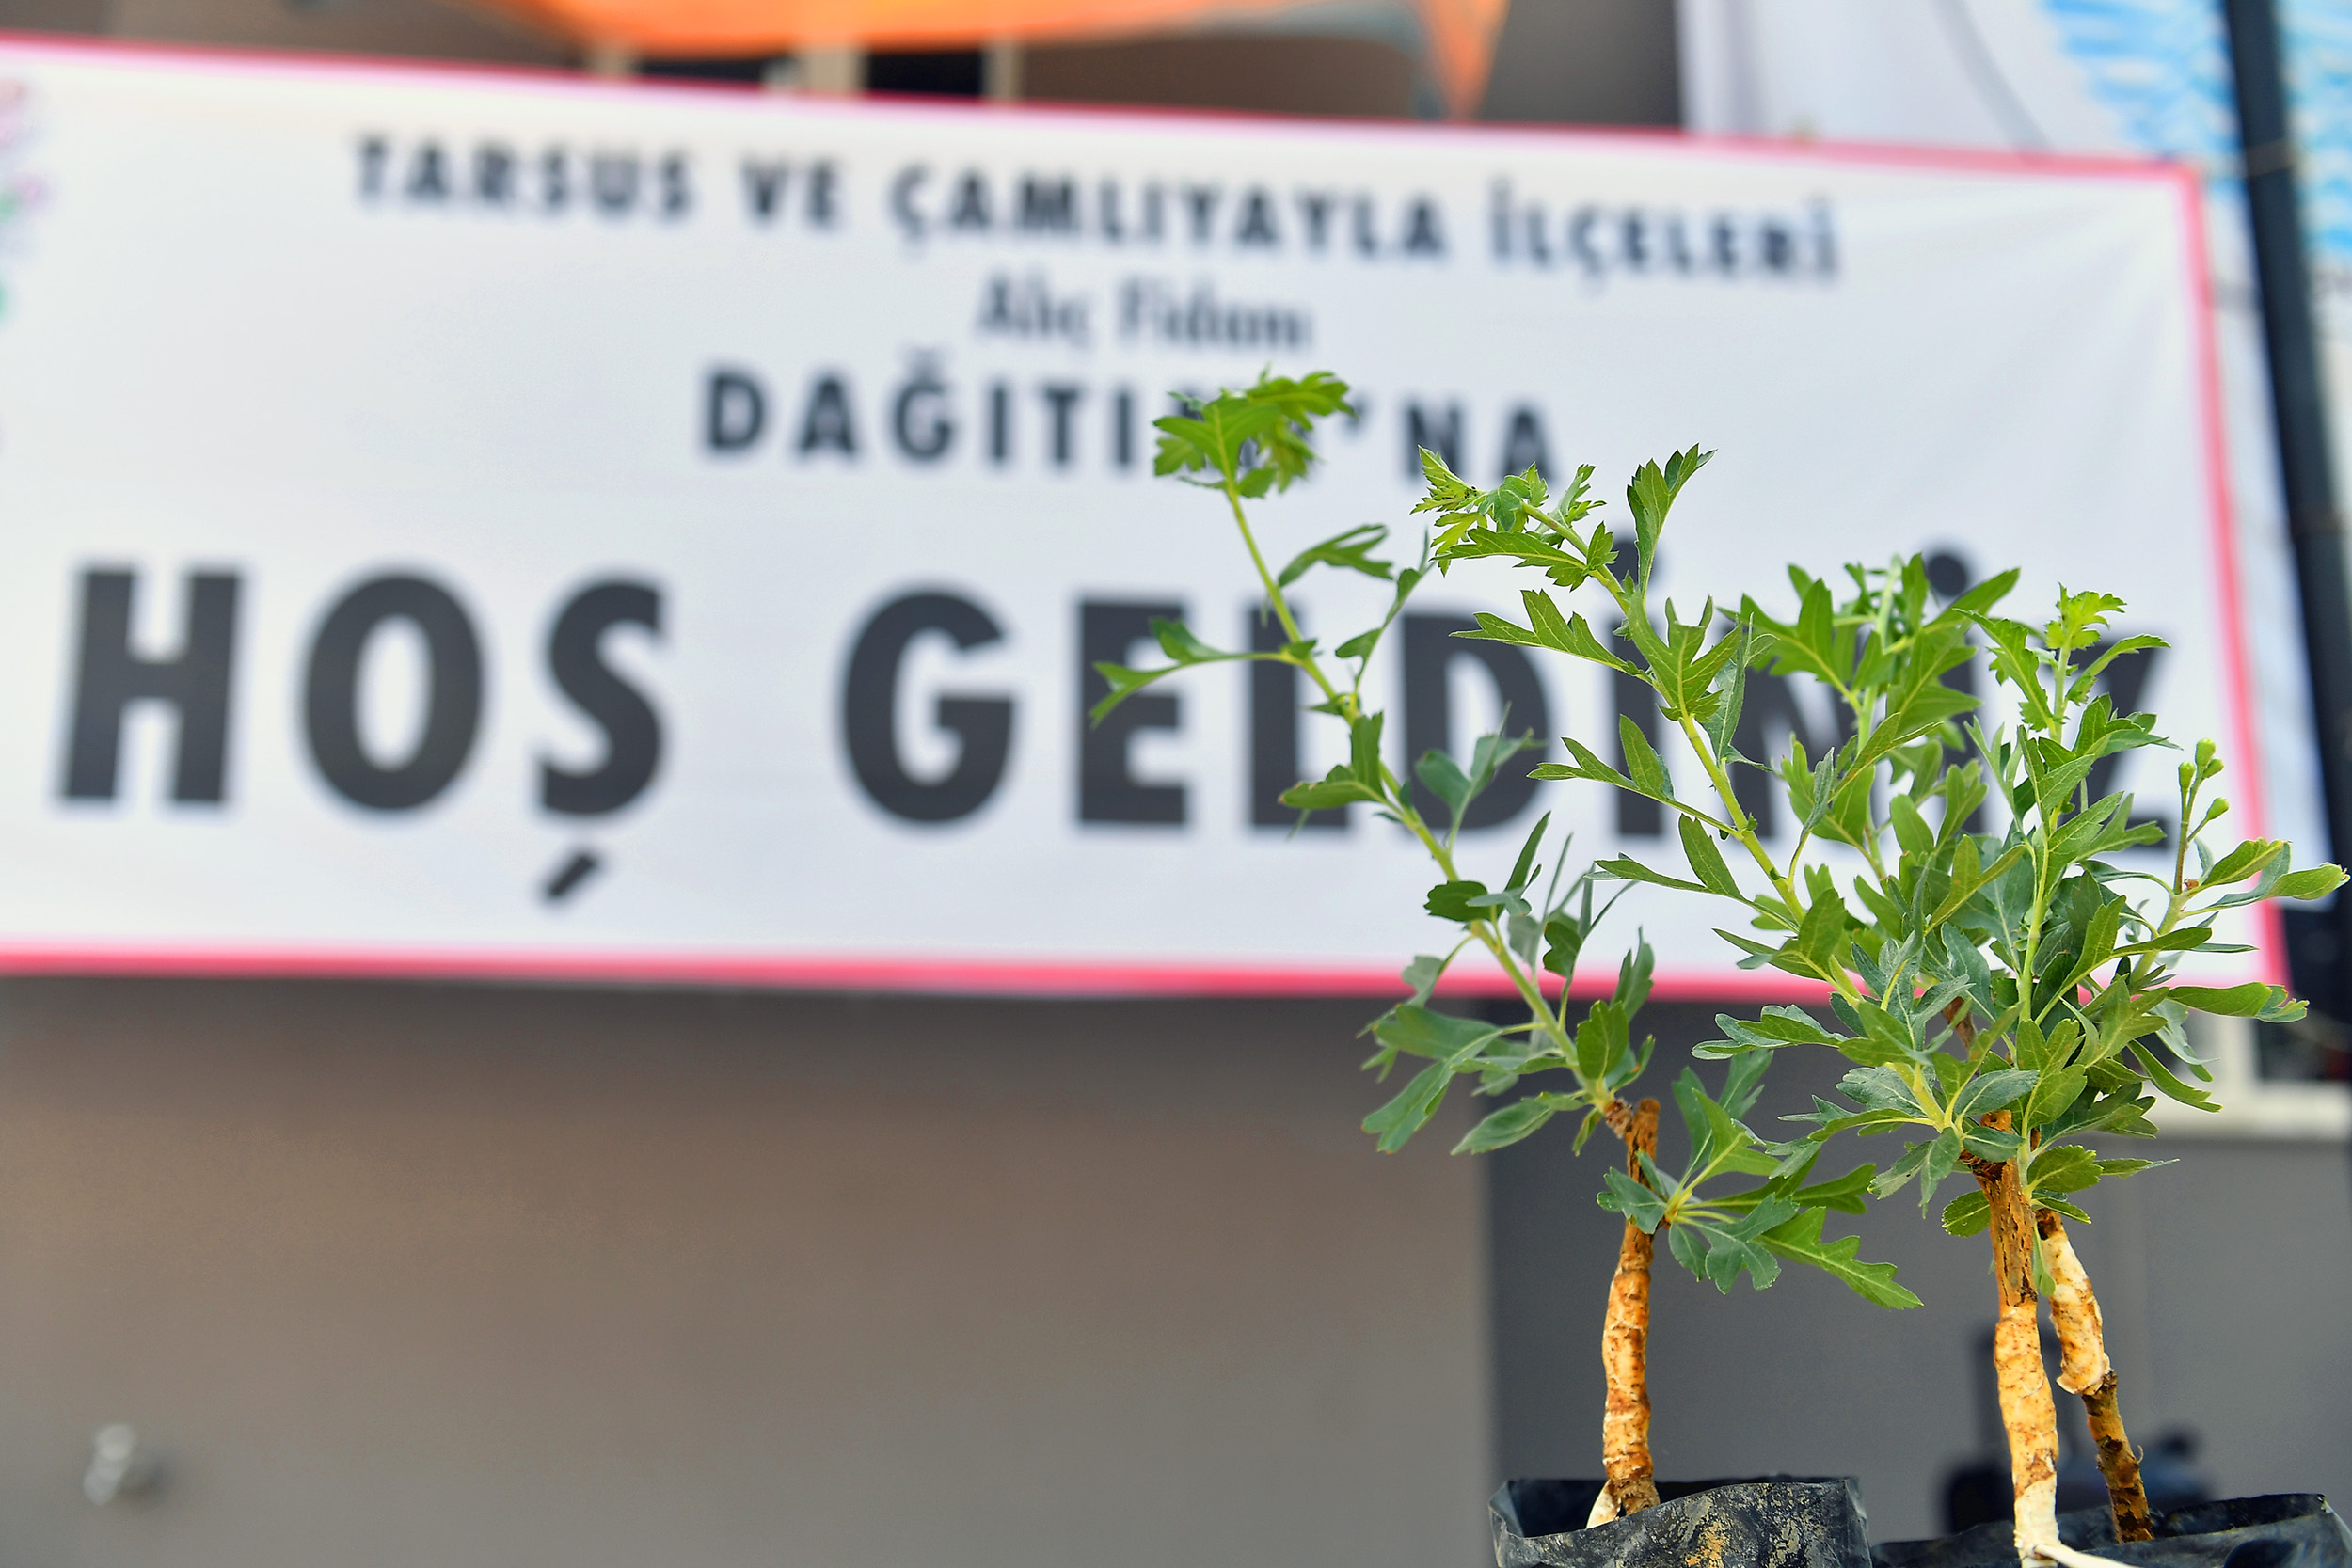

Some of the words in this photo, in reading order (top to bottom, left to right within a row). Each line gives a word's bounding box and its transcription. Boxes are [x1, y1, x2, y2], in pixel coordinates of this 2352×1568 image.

[354, 134, 694, 222] TARSUS
[743, 156, 841, 231] VE
[889, 162, 1449, 261] ÇAMLIYAYLA
[1489, 175, 1841, 290] İLÇELERİ
[56, 564, 668, 905] HOŞ
